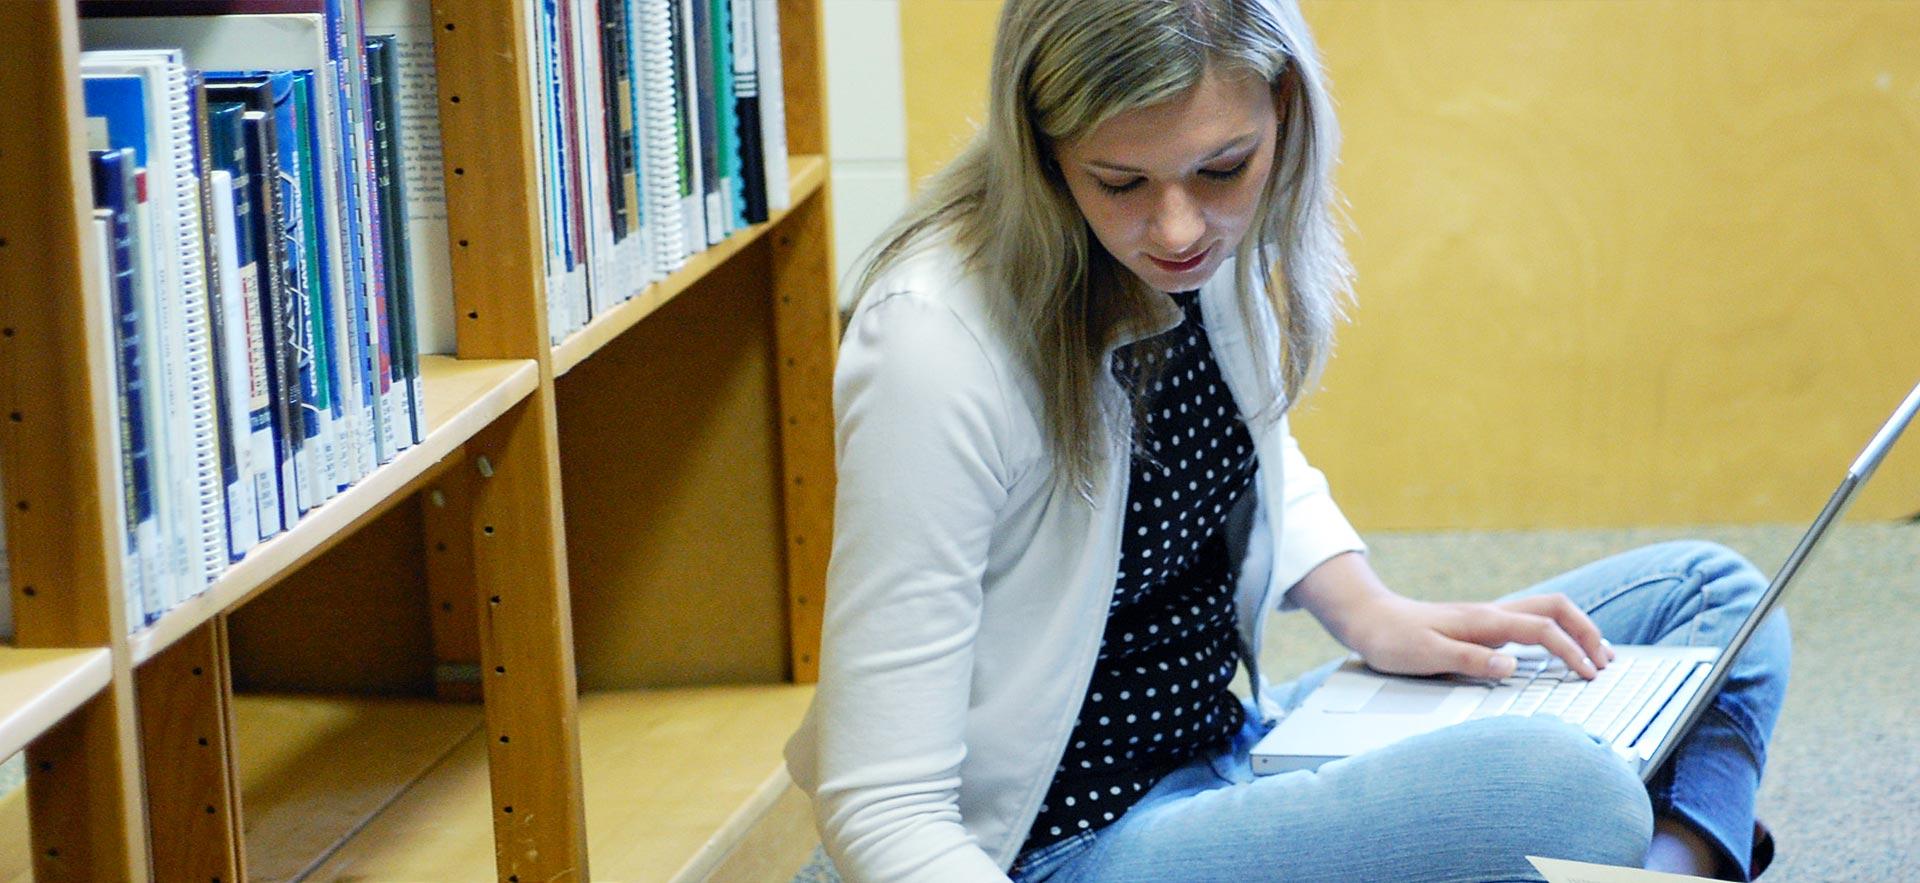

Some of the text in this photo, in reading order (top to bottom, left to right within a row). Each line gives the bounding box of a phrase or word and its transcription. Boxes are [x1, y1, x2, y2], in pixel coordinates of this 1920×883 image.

[299, 247, 309, 289] LAW
[304, 295, 312, 316] IN
[306, 319, 318, 397] CANADA
